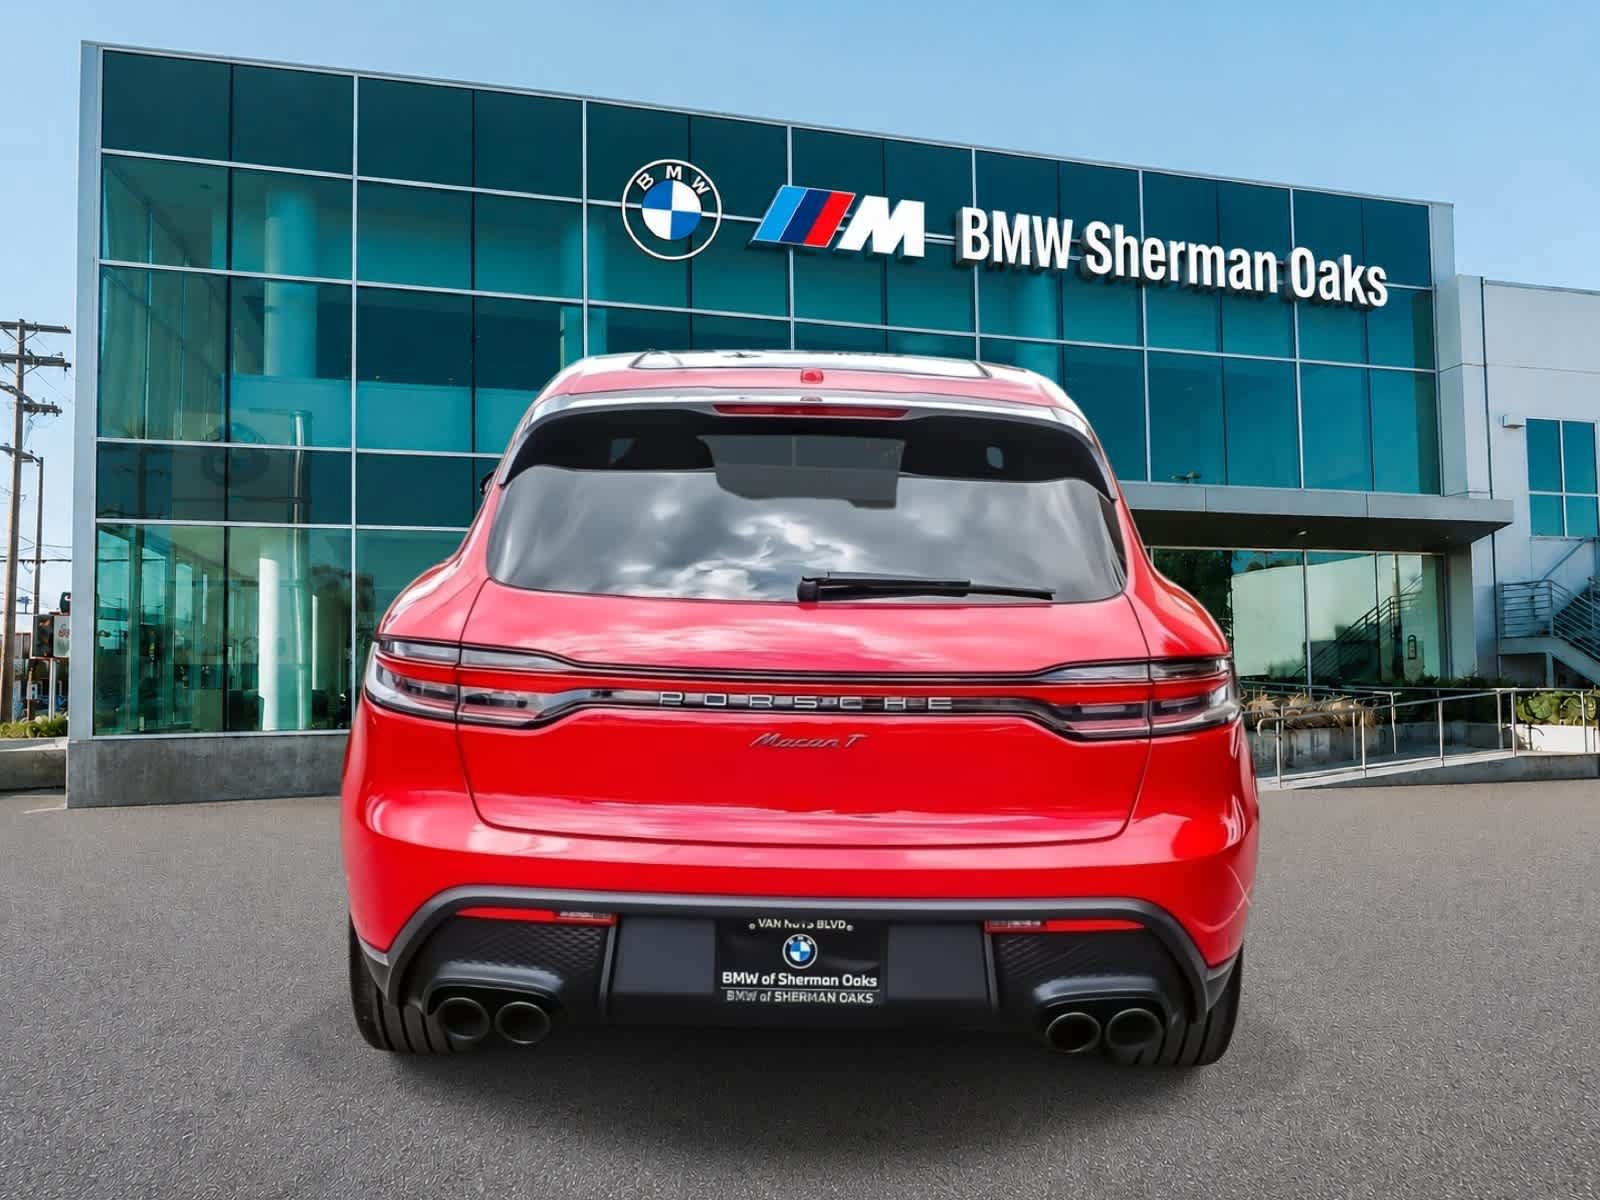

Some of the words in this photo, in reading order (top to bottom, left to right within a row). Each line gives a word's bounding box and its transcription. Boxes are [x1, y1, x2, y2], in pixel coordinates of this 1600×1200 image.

[636, 165, 711, 195] BMW
[834, 195, 925, 258] M
[958, 206, 1073, 270] BMW
[1083, 219, 1279, 294] Sherman
[1287, 246, 1389, 308] Oaks
[659, 691, 952, 710] PORSCHE
[750, 732, 839, 748] Macan
[844, 733, 868, 748] T
[758, 918, 782, 928] VAN
[816, 919, 847, 929] BLVD
[722, 971, 759, 985] BMW
[761, 972, 776, 985] of
[778, 972, 839, 987] Sherman
[842, 974, 878, 987] Oaks
[726, 990, 757, 1001] BMW
[760, 991, 772, 1001] of
[774, 991, 836, 1003] SHERMAN
[839, 992, 874, 1004] OAKS
